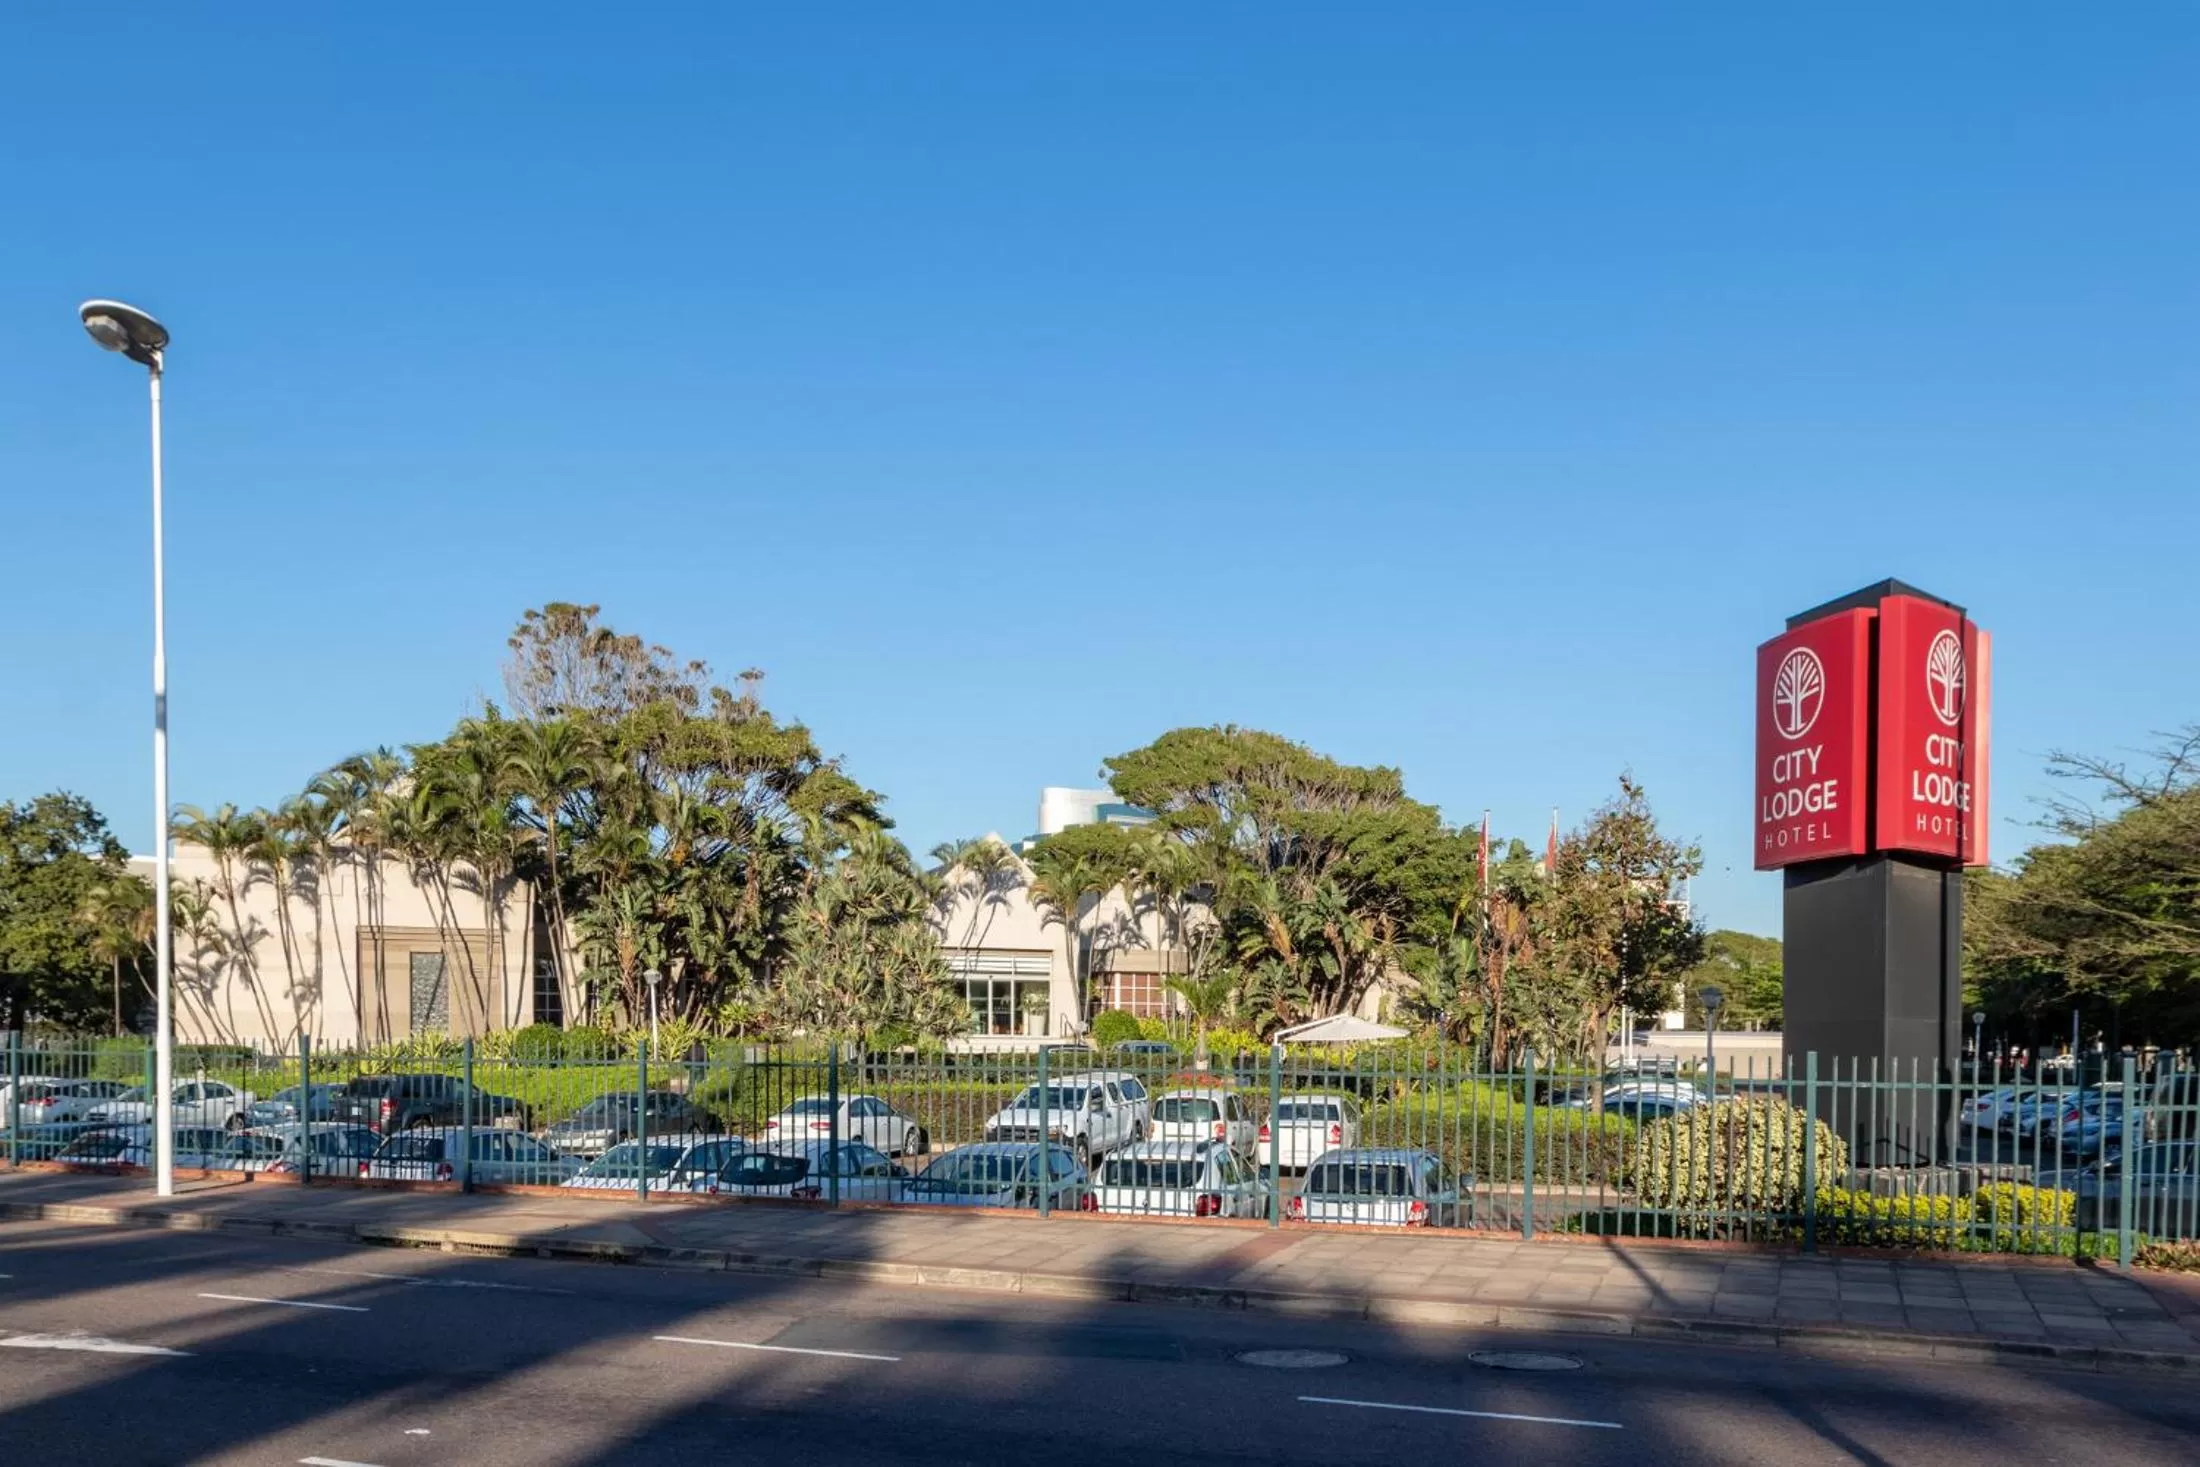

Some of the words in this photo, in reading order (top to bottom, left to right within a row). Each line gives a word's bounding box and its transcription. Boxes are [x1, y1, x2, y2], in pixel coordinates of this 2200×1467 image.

[1773, 745, 1823, 783] CITY
[1926, 734, 1964, 769] CITY
[1763, 780, 1838, 823] LODGE
[1912, 770, 1970, 812] LODGE
[1765, 822, 1831, 850] HOTEL
